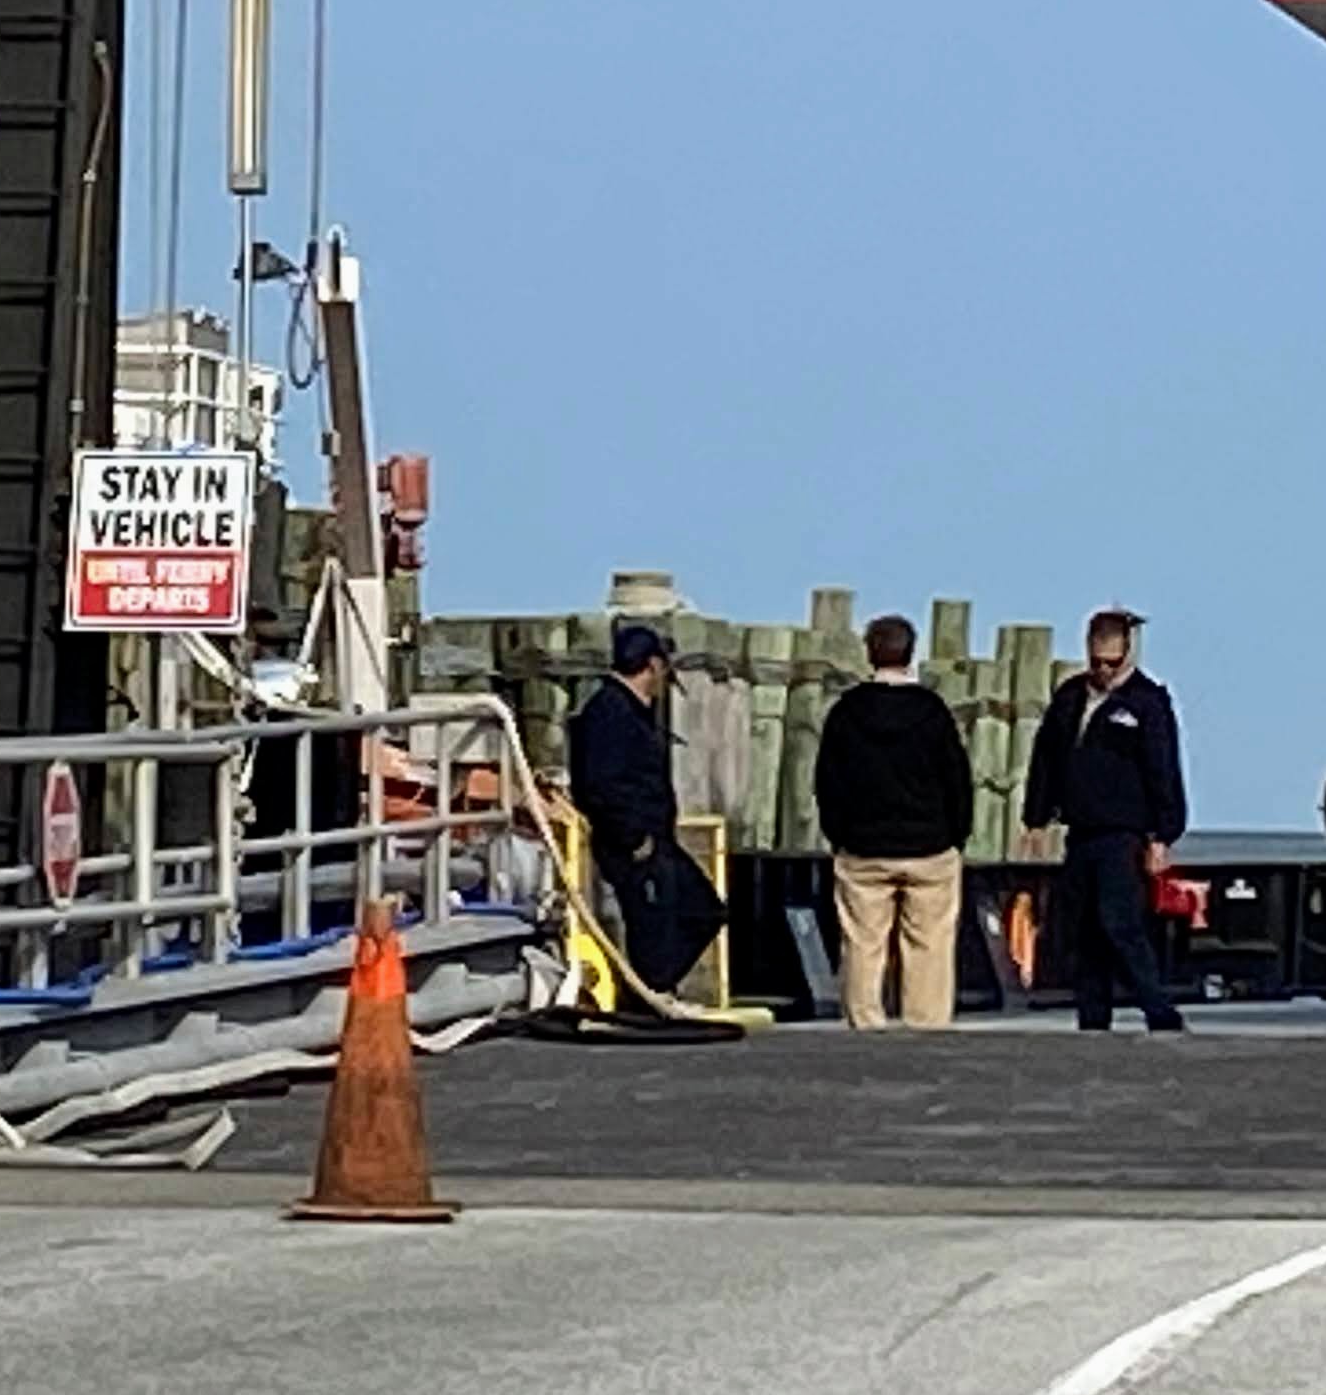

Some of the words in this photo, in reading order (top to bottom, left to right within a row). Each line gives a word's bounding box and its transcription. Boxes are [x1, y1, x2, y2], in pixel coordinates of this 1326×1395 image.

[99, 466, 183, 503] STAY
[193, 466, 227, 503] IN
[89, 510, 235, 547] VEHICLE
[107, 586, 210, 613] DEPARTS
